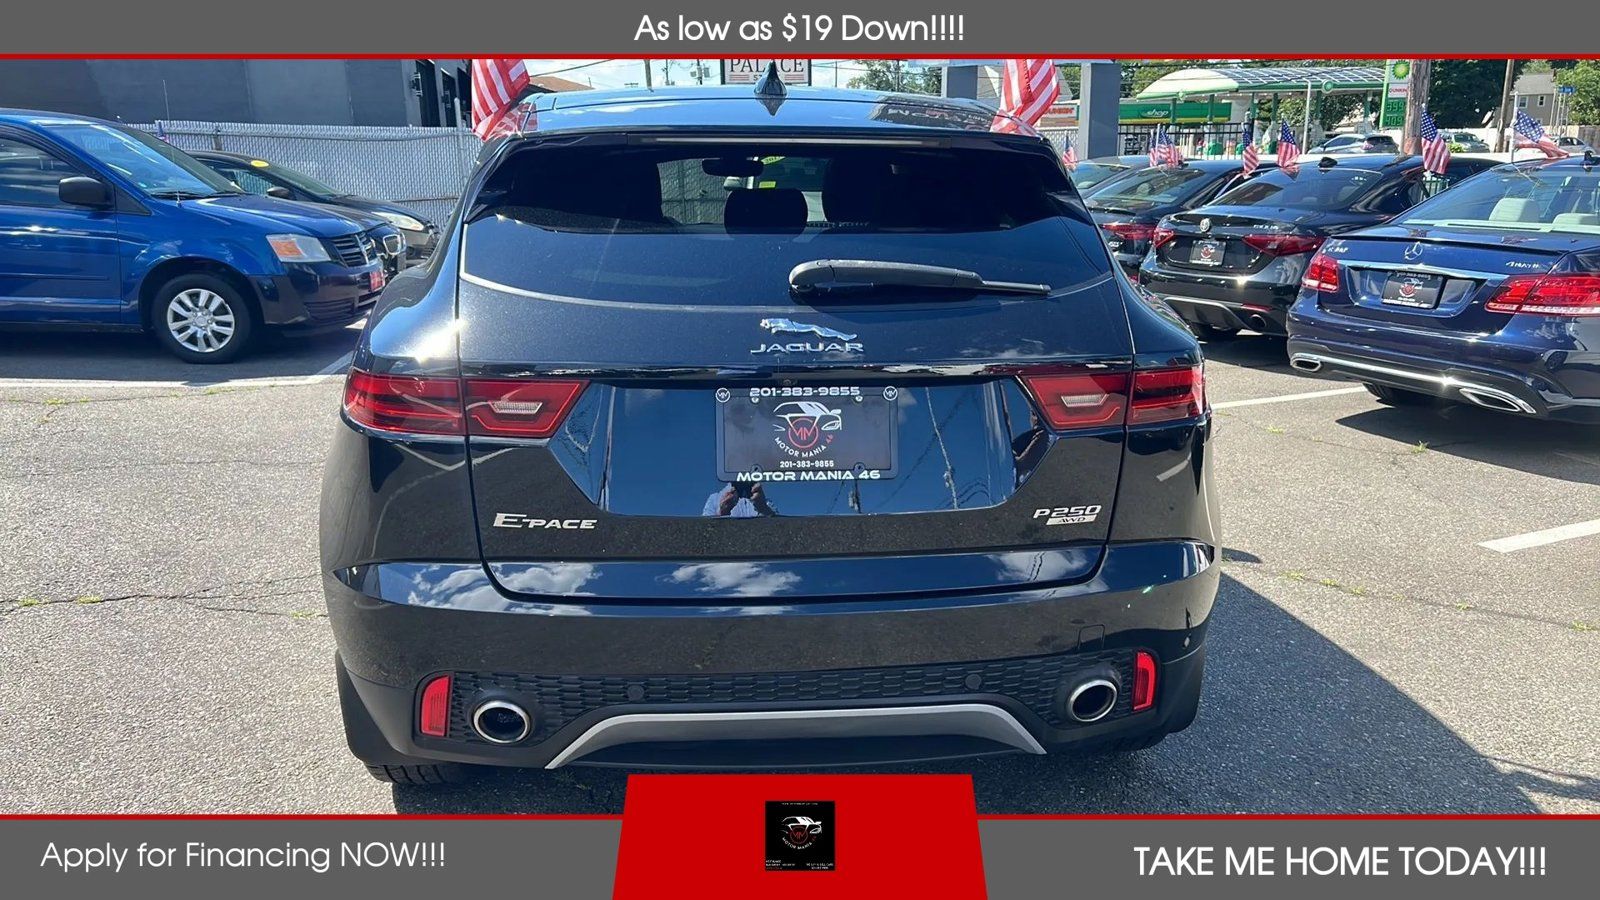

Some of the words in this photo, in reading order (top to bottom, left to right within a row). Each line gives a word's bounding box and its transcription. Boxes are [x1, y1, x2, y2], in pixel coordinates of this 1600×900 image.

[730, 58, 804, 72] PALCE
[1146, 108, 1169, 117] shop
[750, 341, 864, 354] JAGUAR
[749, 386, 861, 397] 201-383-9855
[774, 437, 800, 457] MOTOR
[801, 444, 827, 458] MANIA
[779, 459, 834, 468] 201-383-9855
[736, 471, 796, 482] MOTOR
[799, 470, 856, 481] MANIA
[857, 470, 881, 480] 46
[1033, 505, 1102, 519] P250
[493, 513, 598, 529] E-PACE
[1058, 516, 1087, 524] AWD
